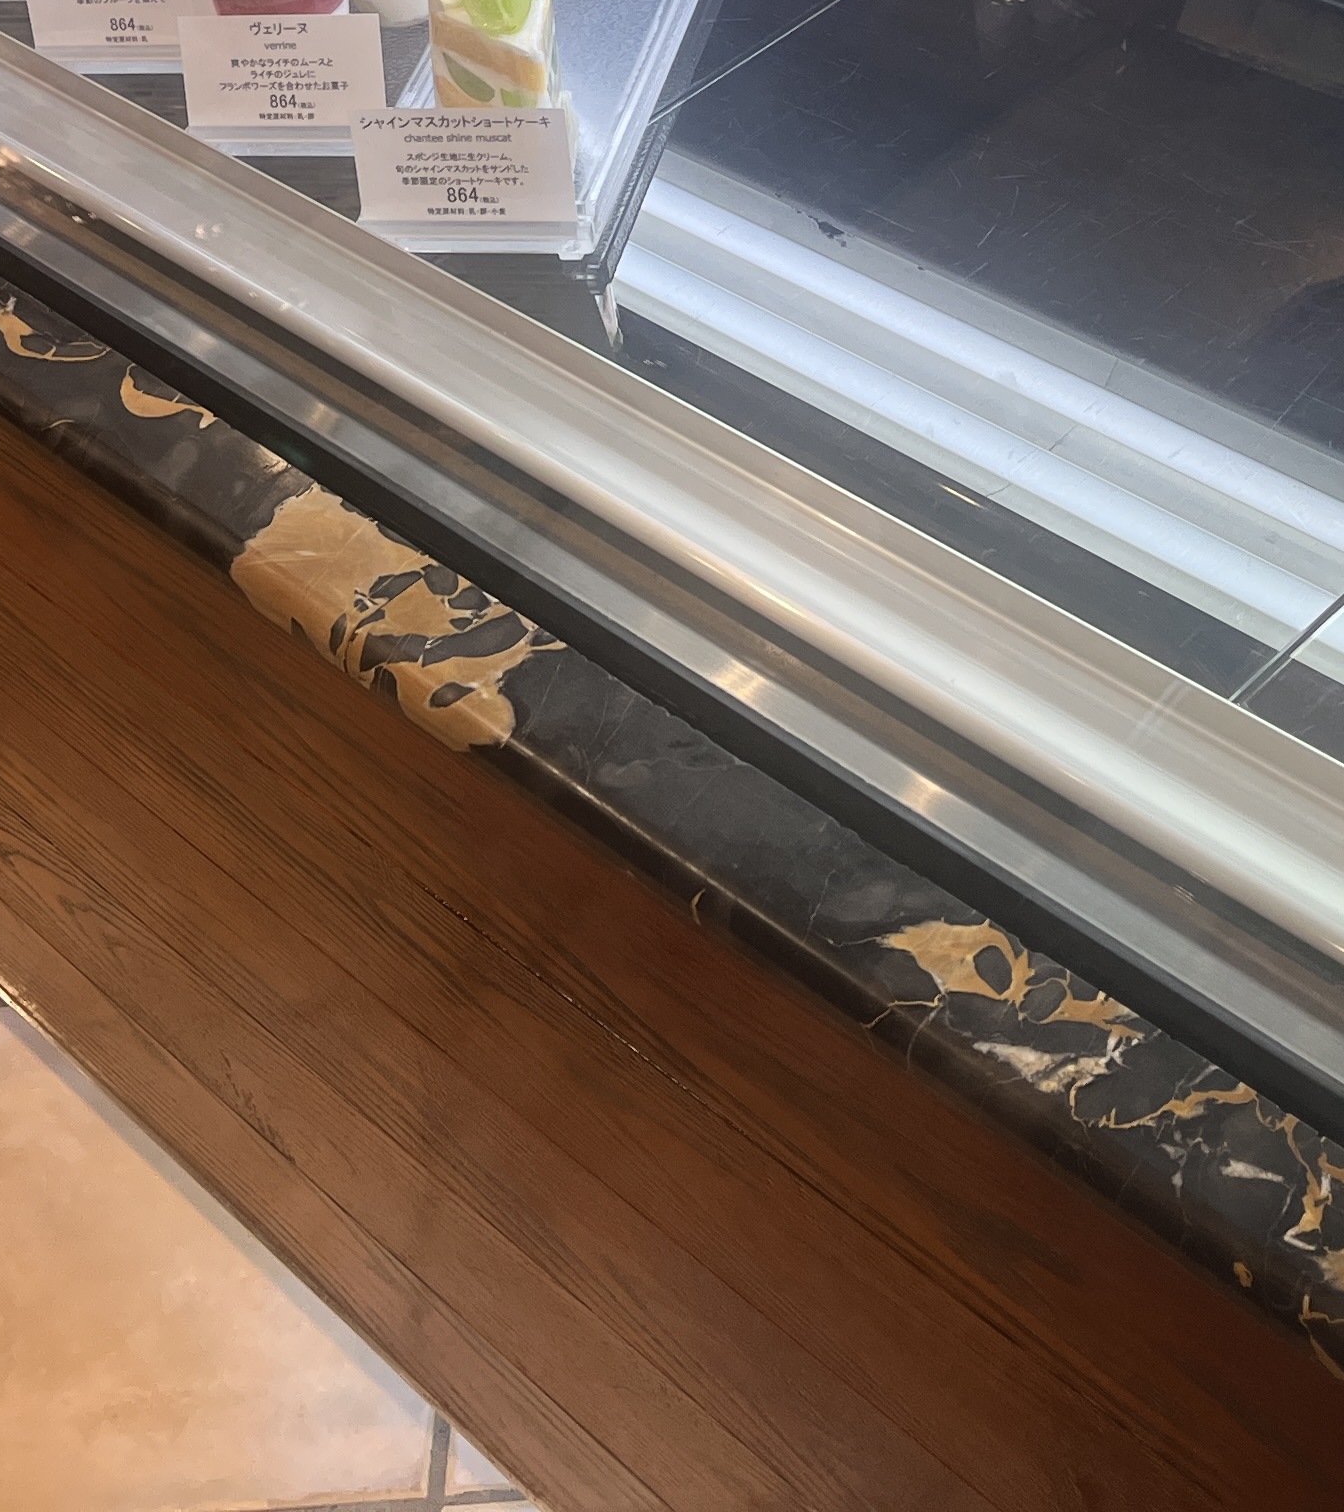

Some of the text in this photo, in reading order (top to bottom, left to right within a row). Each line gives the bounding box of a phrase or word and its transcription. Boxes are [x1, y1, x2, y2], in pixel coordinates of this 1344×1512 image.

[110, 17, 136, 31] 864
[249, 21, 309, 35] ヴェリーヌ
[231, 58, 334, 68] 爽やかなライチのムースと
[250, 69, 317, 79] ライチのジュレに
[270, 94, 298, 109] 864
[360, 115, 552, 130] シャインマスカットショートケーキ
[446, 133, 472, 143] shine
[476, 133, 513, 143] muscat
[406, 152, 513, 162] スポンジ生地に生クリーム、
[396, 164, 529, 174] 旬のシャインマスカットをサンドした
[402, 176, 525, 186] 季節限定のショートケーキです。
[447, 187, 479, 203] 864
